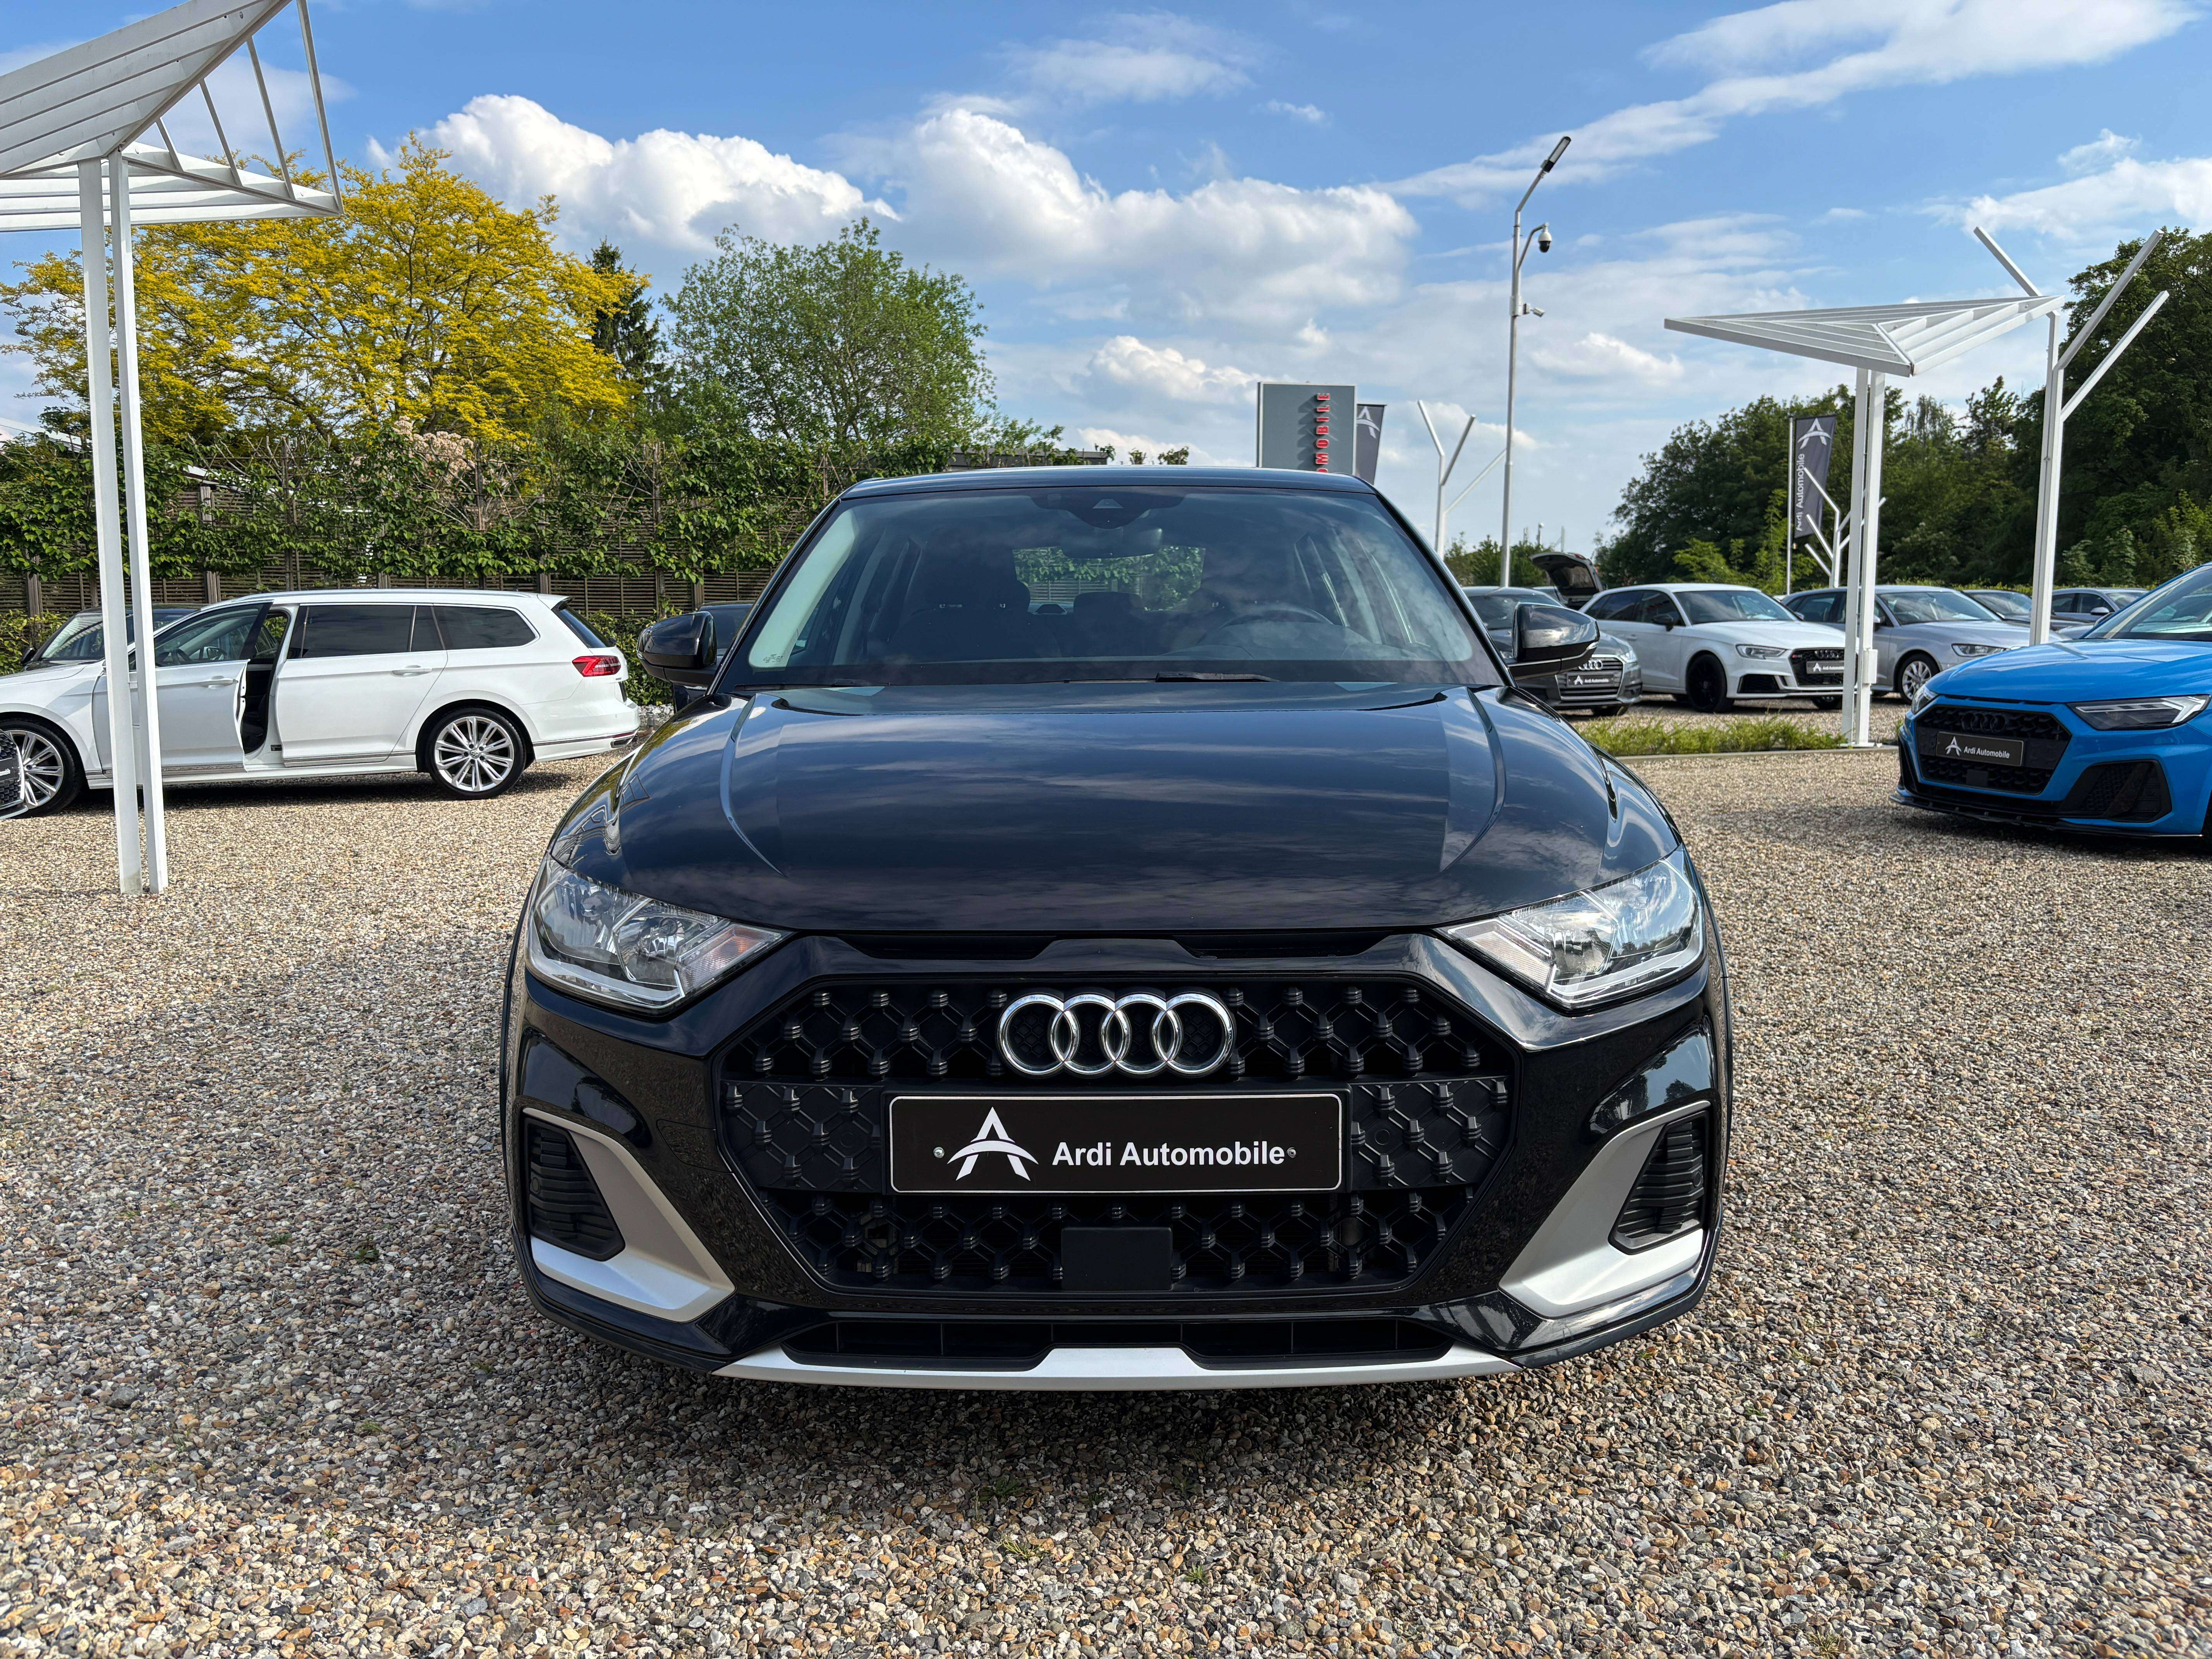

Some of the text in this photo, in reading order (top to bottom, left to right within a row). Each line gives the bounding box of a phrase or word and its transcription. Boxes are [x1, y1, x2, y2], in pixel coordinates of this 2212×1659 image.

[1796, 453, 1805, 508] Automobile
[1964, 746, 2010, 759] Ardi Automobile
[1052, 1141, 1285, 1166] Ardi Automobile
